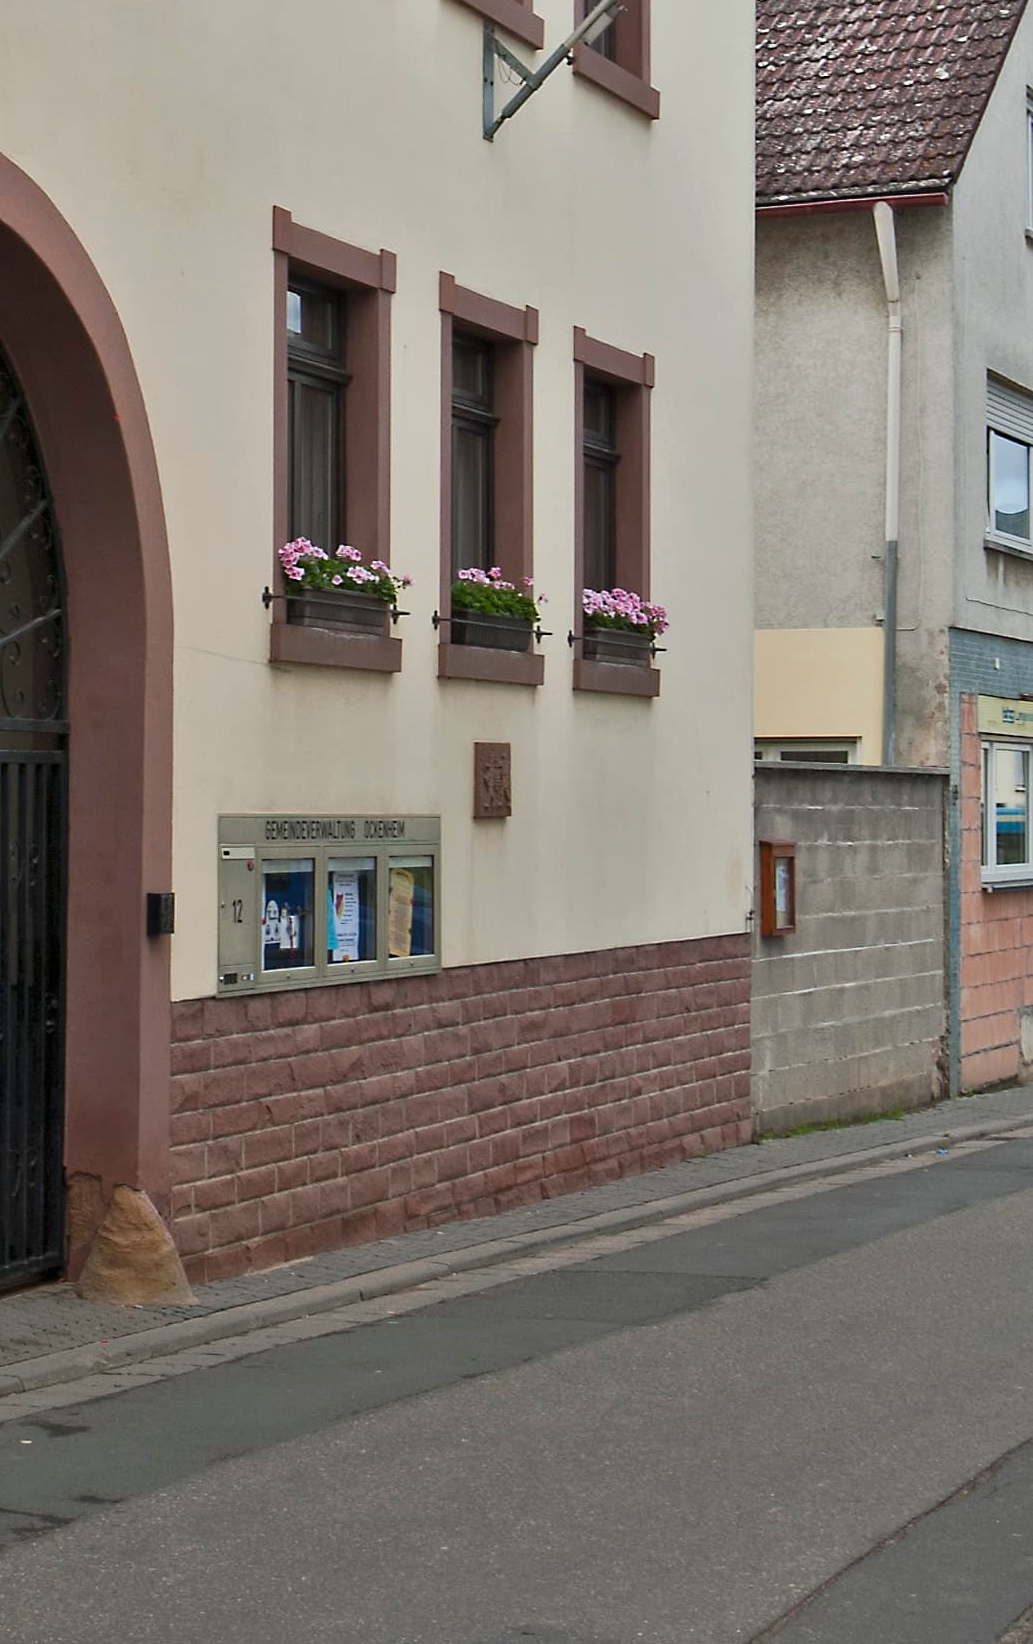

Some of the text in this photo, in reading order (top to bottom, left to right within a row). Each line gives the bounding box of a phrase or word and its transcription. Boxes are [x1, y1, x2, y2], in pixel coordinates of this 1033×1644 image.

[265, 820, 405, 840] GEMEINDEVERWALTUNG OCKENHEIM
[232, 899, 243, 923] 12
